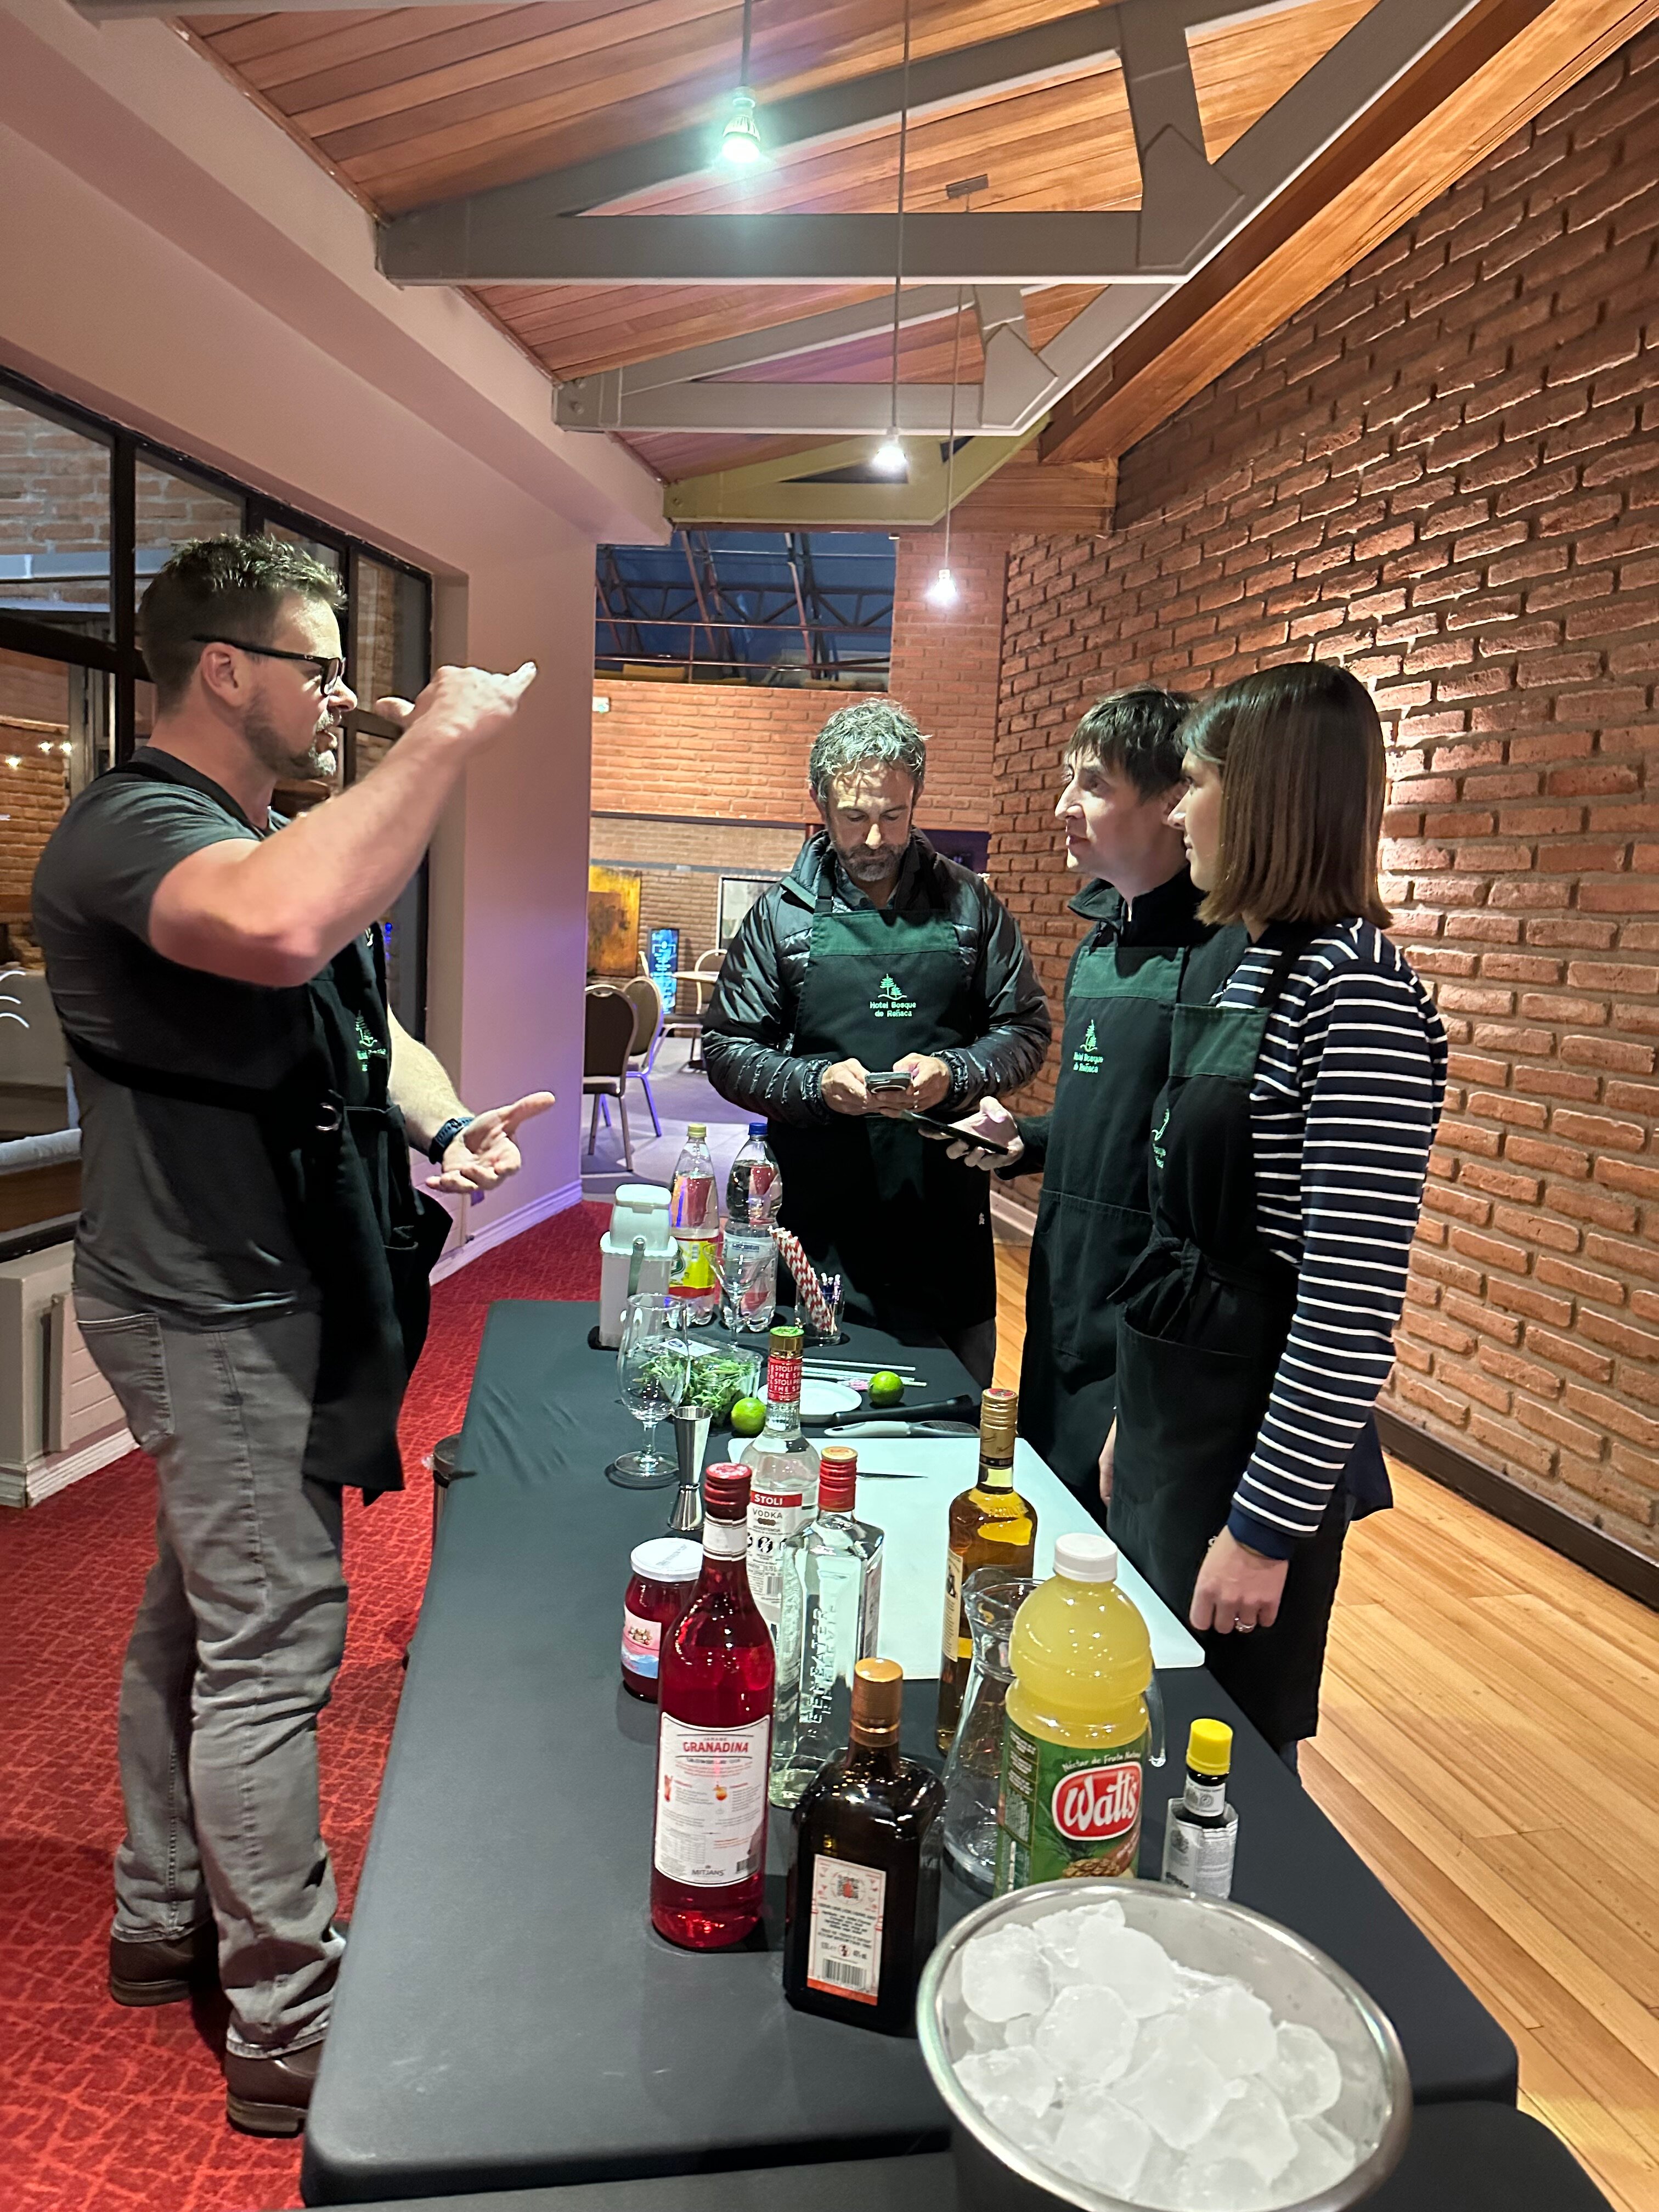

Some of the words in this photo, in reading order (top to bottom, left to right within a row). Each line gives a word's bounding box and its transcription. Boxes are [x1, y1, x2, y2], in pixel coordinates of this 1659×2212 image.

[891, 1001, 916, 1009] Bosque
[754, 1494, 783, 1505] STOLI
[752, 1508, 783, 1519] VODKA
[682, 1742, 749, 1753] GRANADINA
[1091, 1756, 1102, 1764] de
[1104, 1753, 1124, 1764] Fruta
[1064, 1770, 1138, 1831] Watt's
